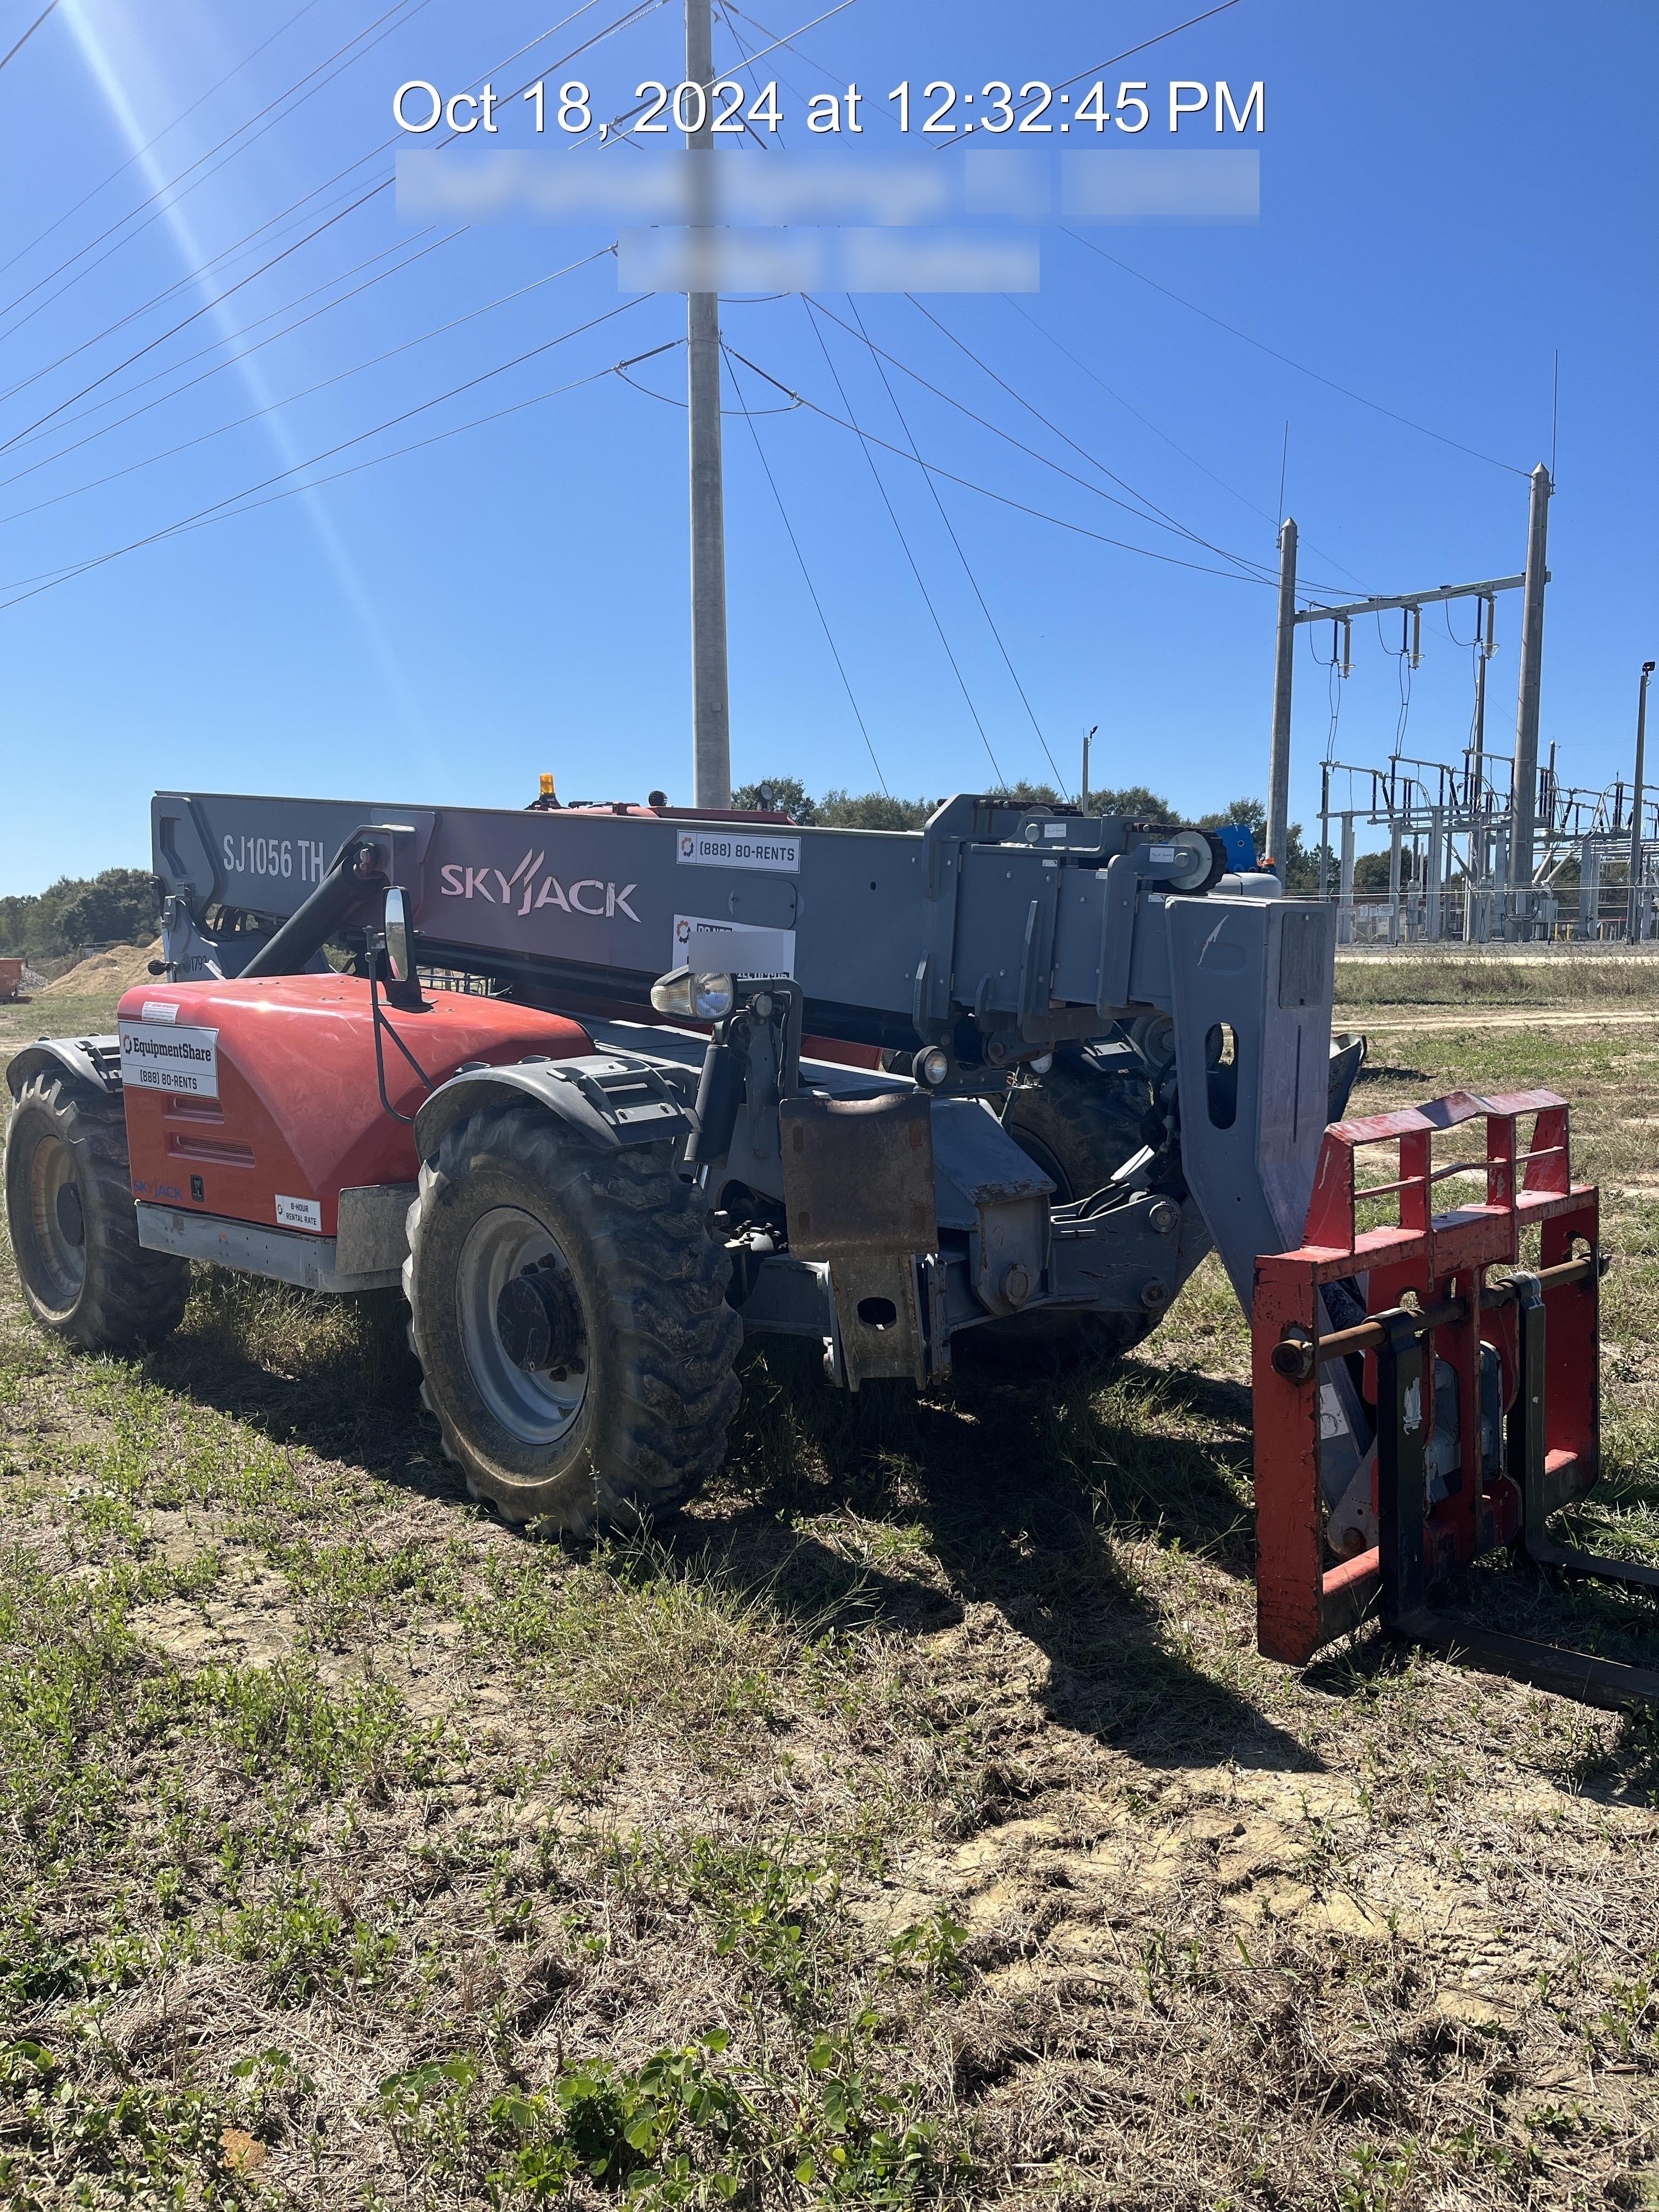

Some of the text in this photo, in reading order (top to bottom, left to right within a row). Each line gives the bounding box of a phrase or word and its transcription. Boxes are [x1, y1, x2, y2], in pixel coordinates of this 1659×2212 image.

[223, 834, 324, 883] SJ1056 TH
[700, 841, 794, 861] (888) 80-RENTS
[441, 847, 642, 923] SKYJACK
[133, 1037, 212, 1062] EquipmentShare
[140, 1069, 197, 1090] (888) 80-RENTS
[286, 1212, 317, 1225] RENTAL RATE
